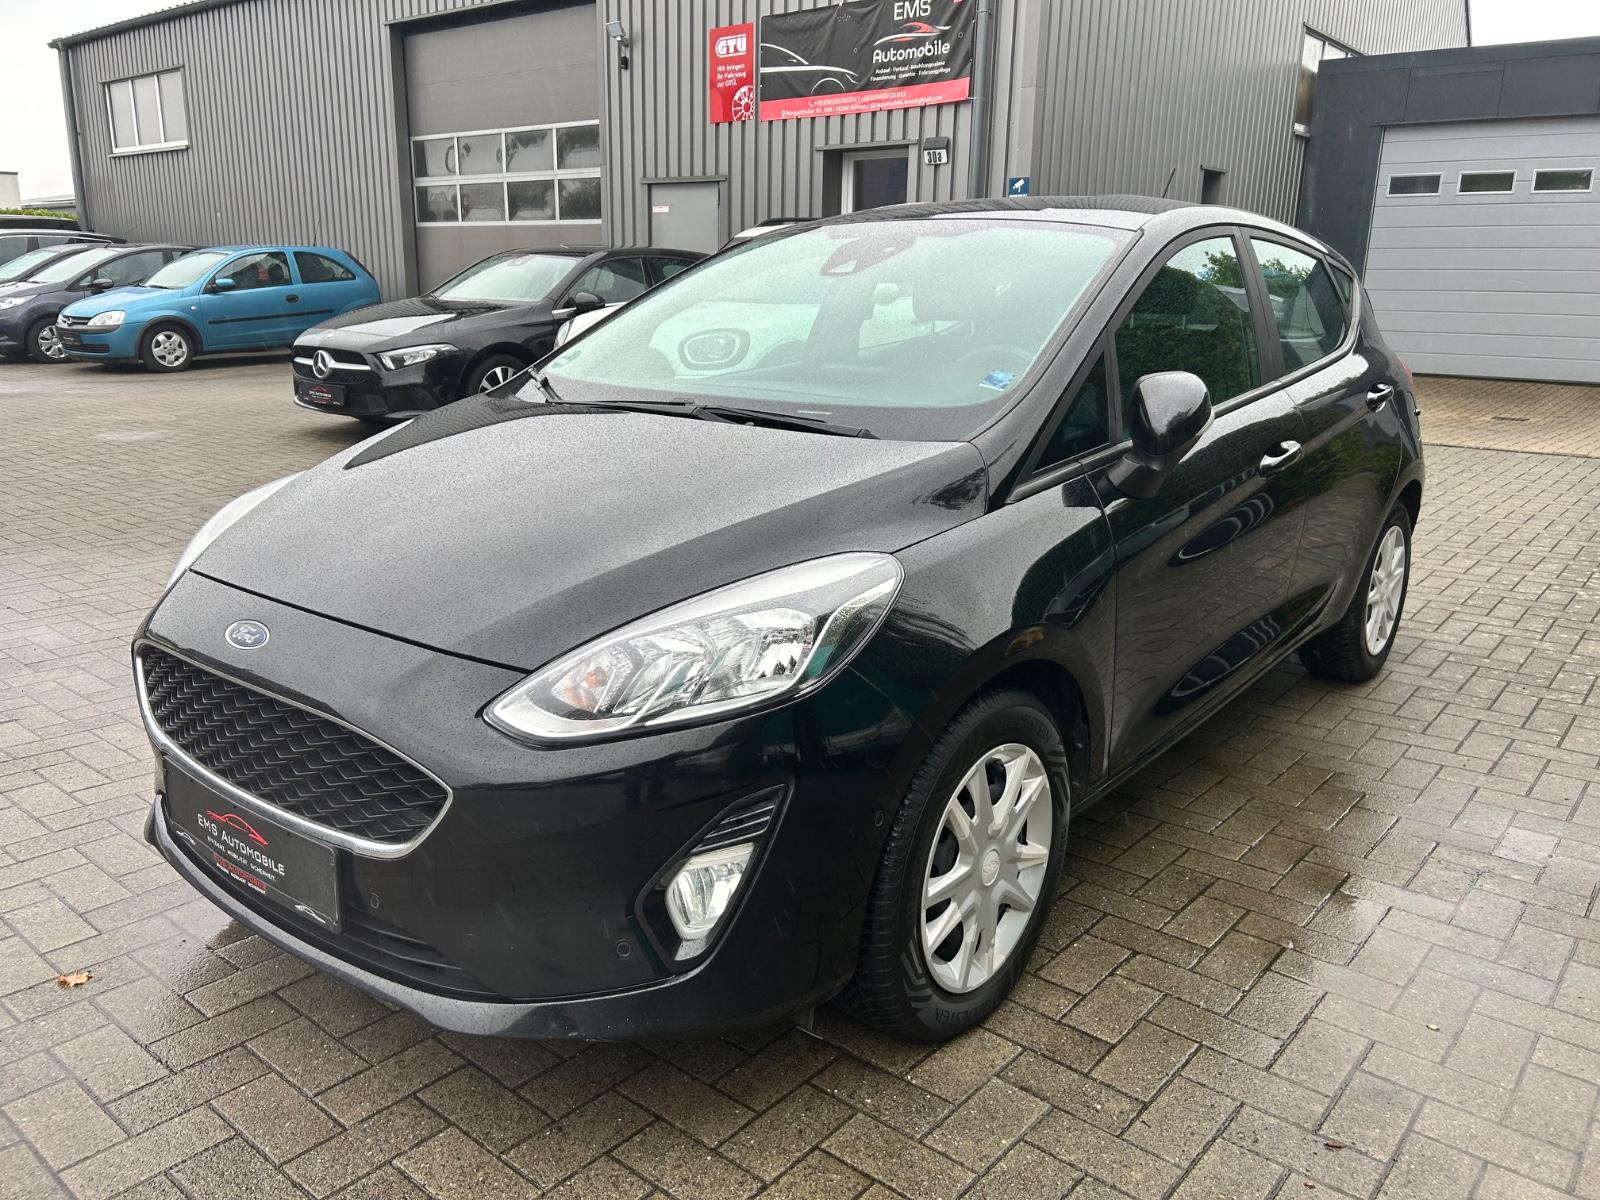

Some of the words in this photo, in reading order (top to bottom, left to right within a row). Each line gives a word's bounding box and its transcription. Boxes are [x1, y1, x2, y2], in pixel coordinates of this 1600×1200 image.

[894, 0, 931, 20] EMS
[872, 40, 951, 63] Automobile
[926, 150, 942, 164] 30a
[232, 624, 260, 644] Ford
[197, 813, 218, 836] EMS
[221, 830, 285, 876] AUTOMOBILE
